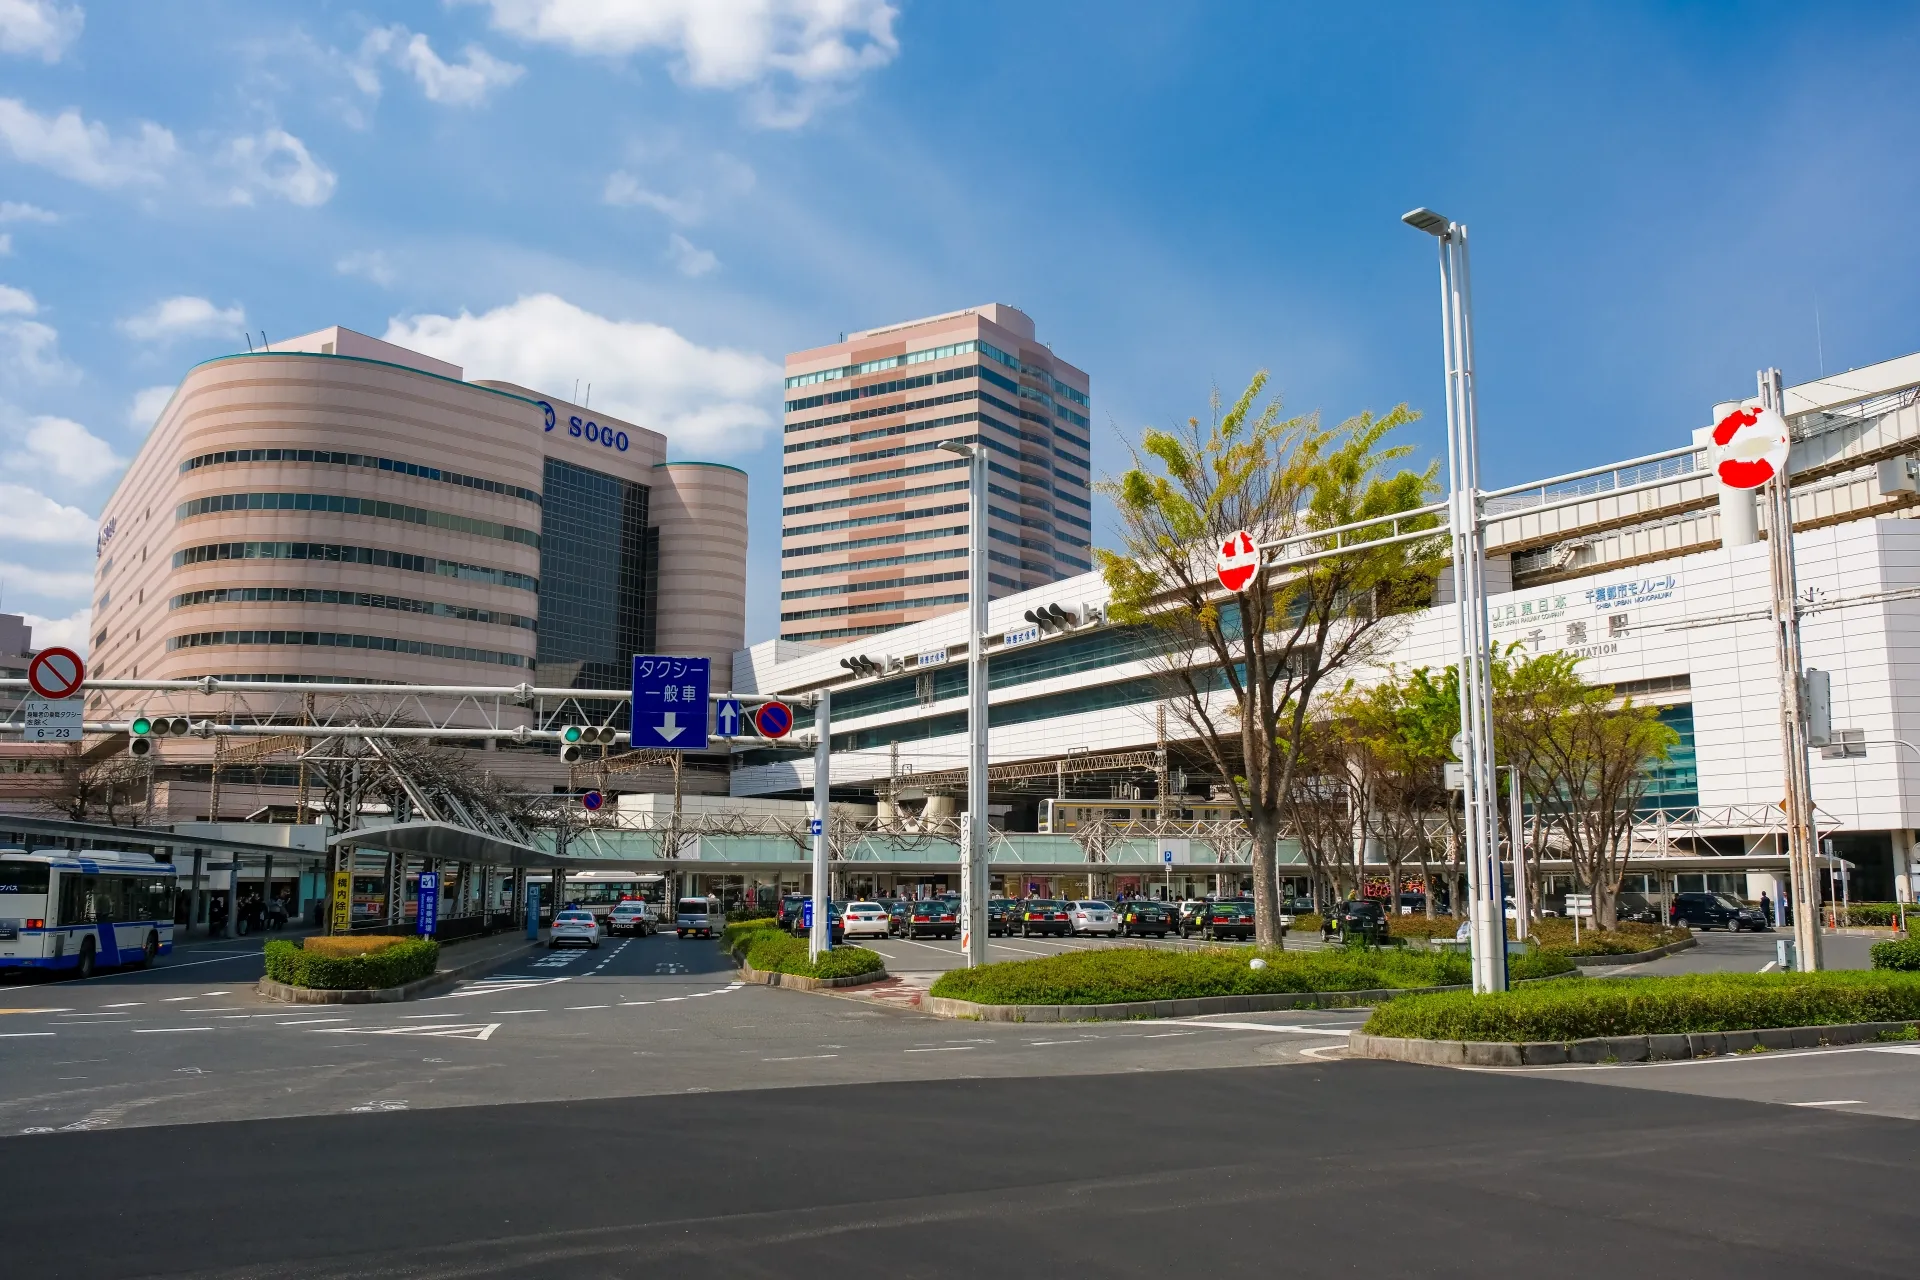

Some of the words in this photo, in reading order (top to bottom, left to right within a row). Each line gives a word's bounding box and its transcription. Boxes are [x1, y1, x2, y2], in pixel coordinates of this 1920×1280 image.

[569, 416, 629, 452] SOGO
[1585, 575, 1676, 604] 千葉都市モノレール
[1614, 598, 1632, 607] URBAN
[1492, 621, 1506, 629] EAST
[1505, 618, 1520, 627] JAPAN
[1520, 614, 1541, 625] RAILWAY
[1541, 610, 1565, 621] COMPANY
[1574, 643, 1618, 659] STATION
[639, 660, 704, 678] タクシー
[645, 684, 696, 703] 一般車
[27, 718, 48, 726] を除く
